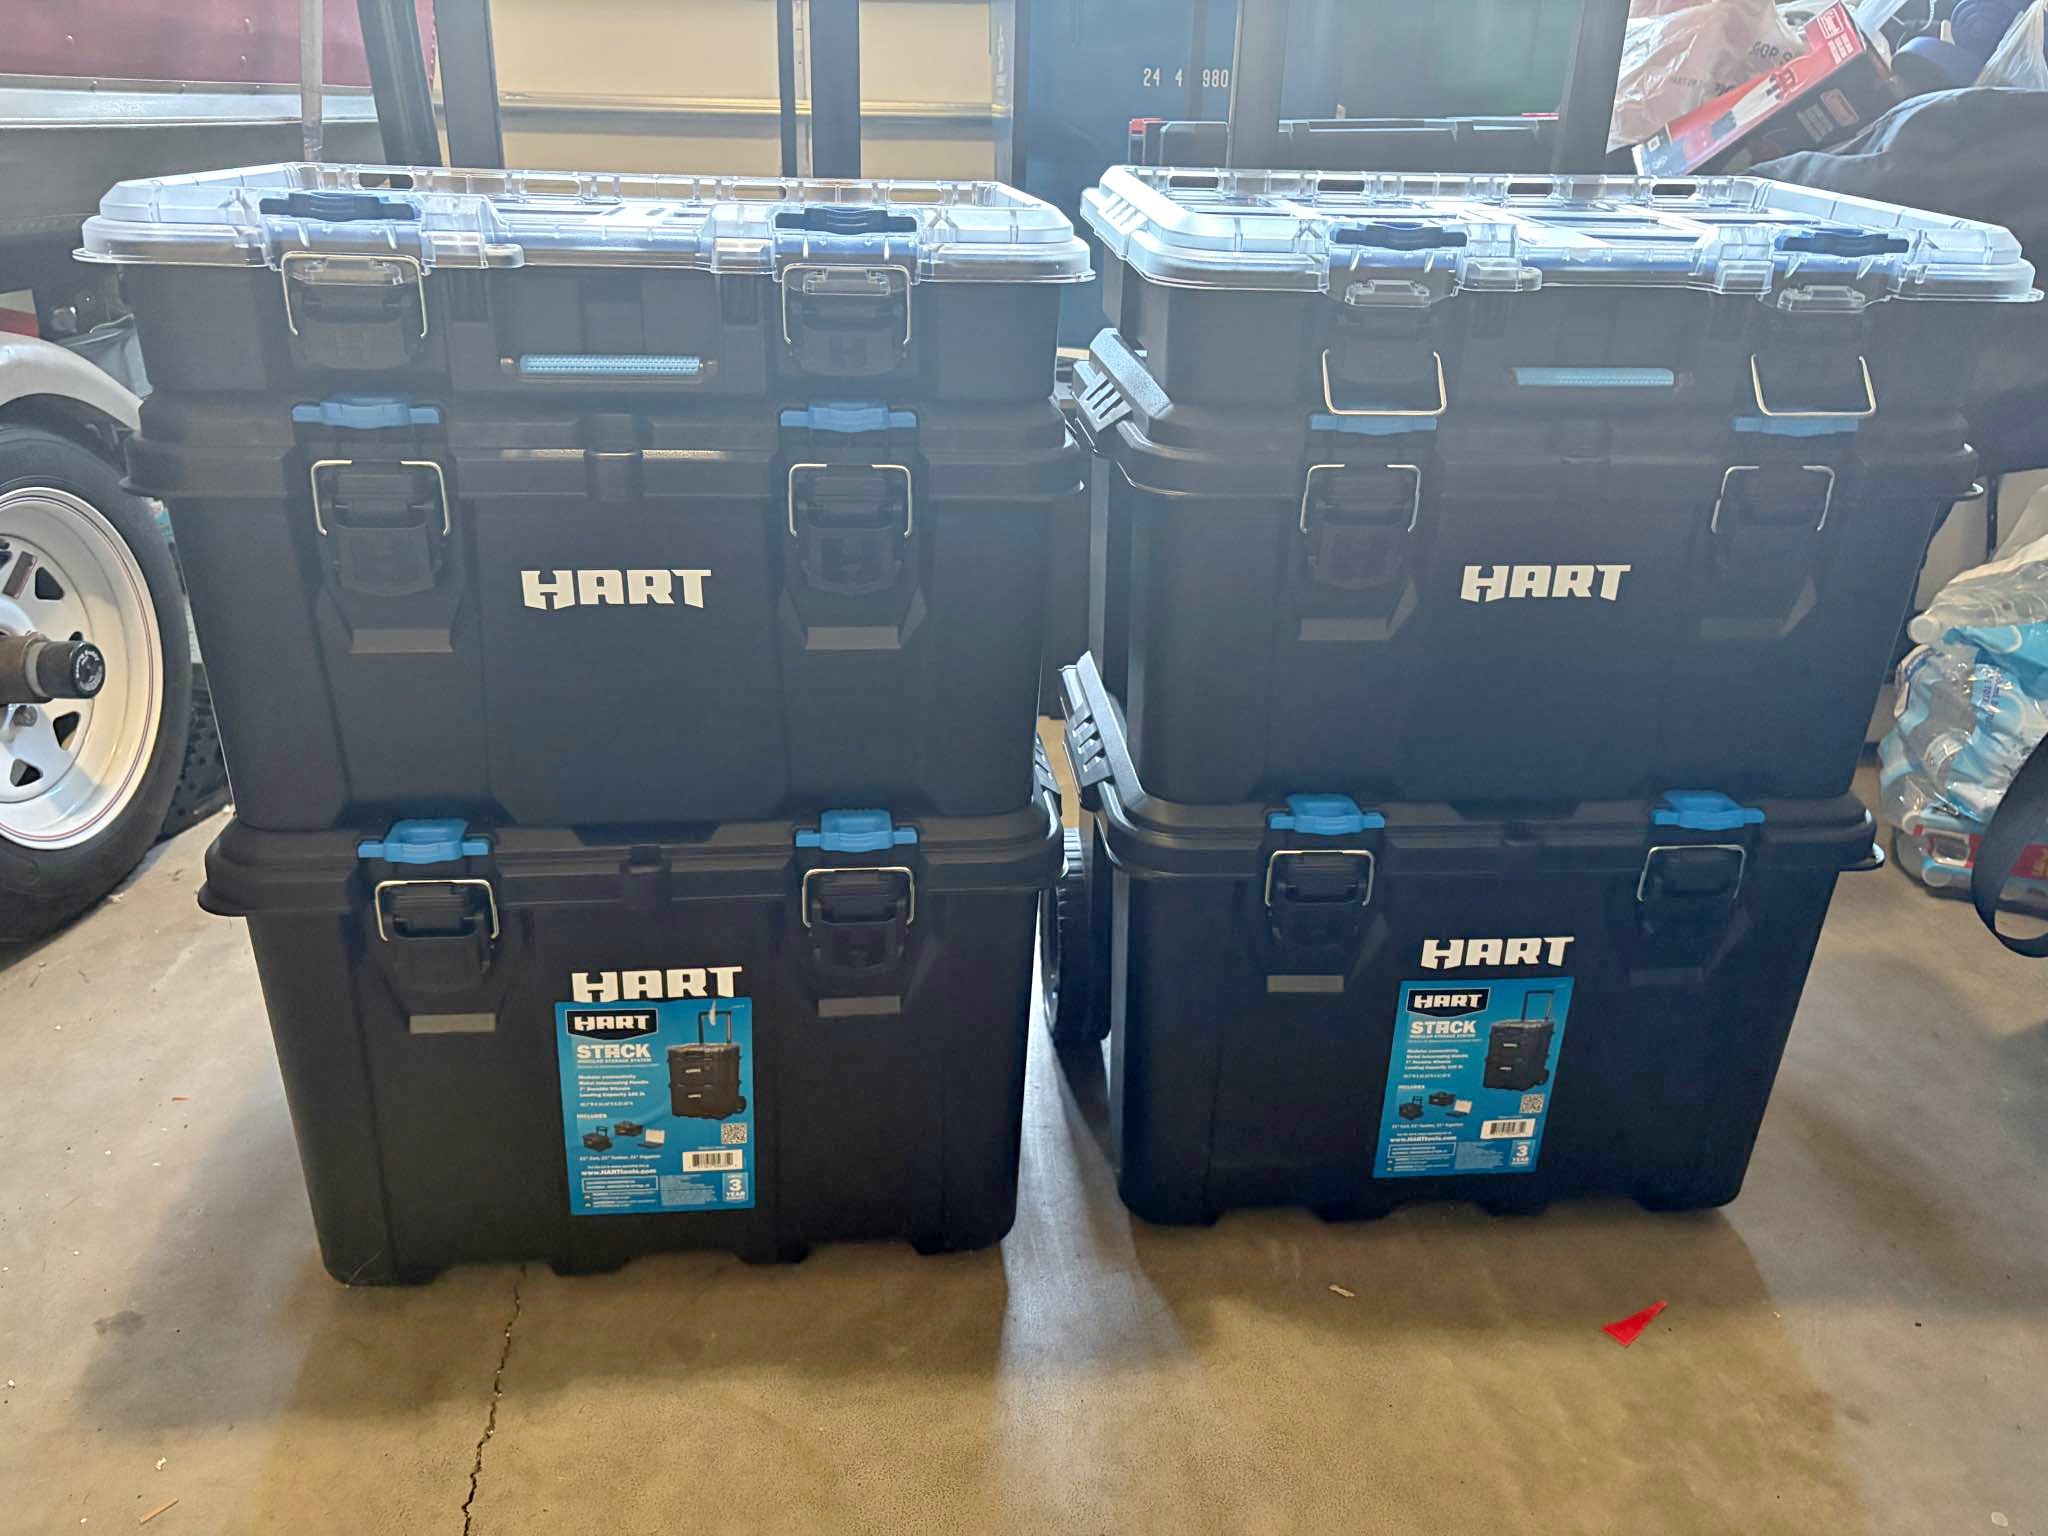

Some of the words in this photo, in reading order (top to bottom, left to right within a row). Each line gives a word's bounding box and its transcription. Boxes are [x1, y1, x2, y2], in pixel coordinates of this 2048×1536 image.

[1143, 67, 1160, 87] 24
[1202, 68, 1229, 88] 980
[521, 569, 712, 610] HART
[1460, 564, 1632, 602] HART
[1420, 936, 1575, 969] HART
[571, 966, 742, 1003] HART
[1414, 993, 1483, 1009] HART
[574, 1015, 650, 1032] HART
[1410, 1020, 1477, 1034] STACK
[577, 1043, 651, 1059] STACK
[1516, 1145, 1528, 1157] 3
[729, 1178, 742, 1191] 3
